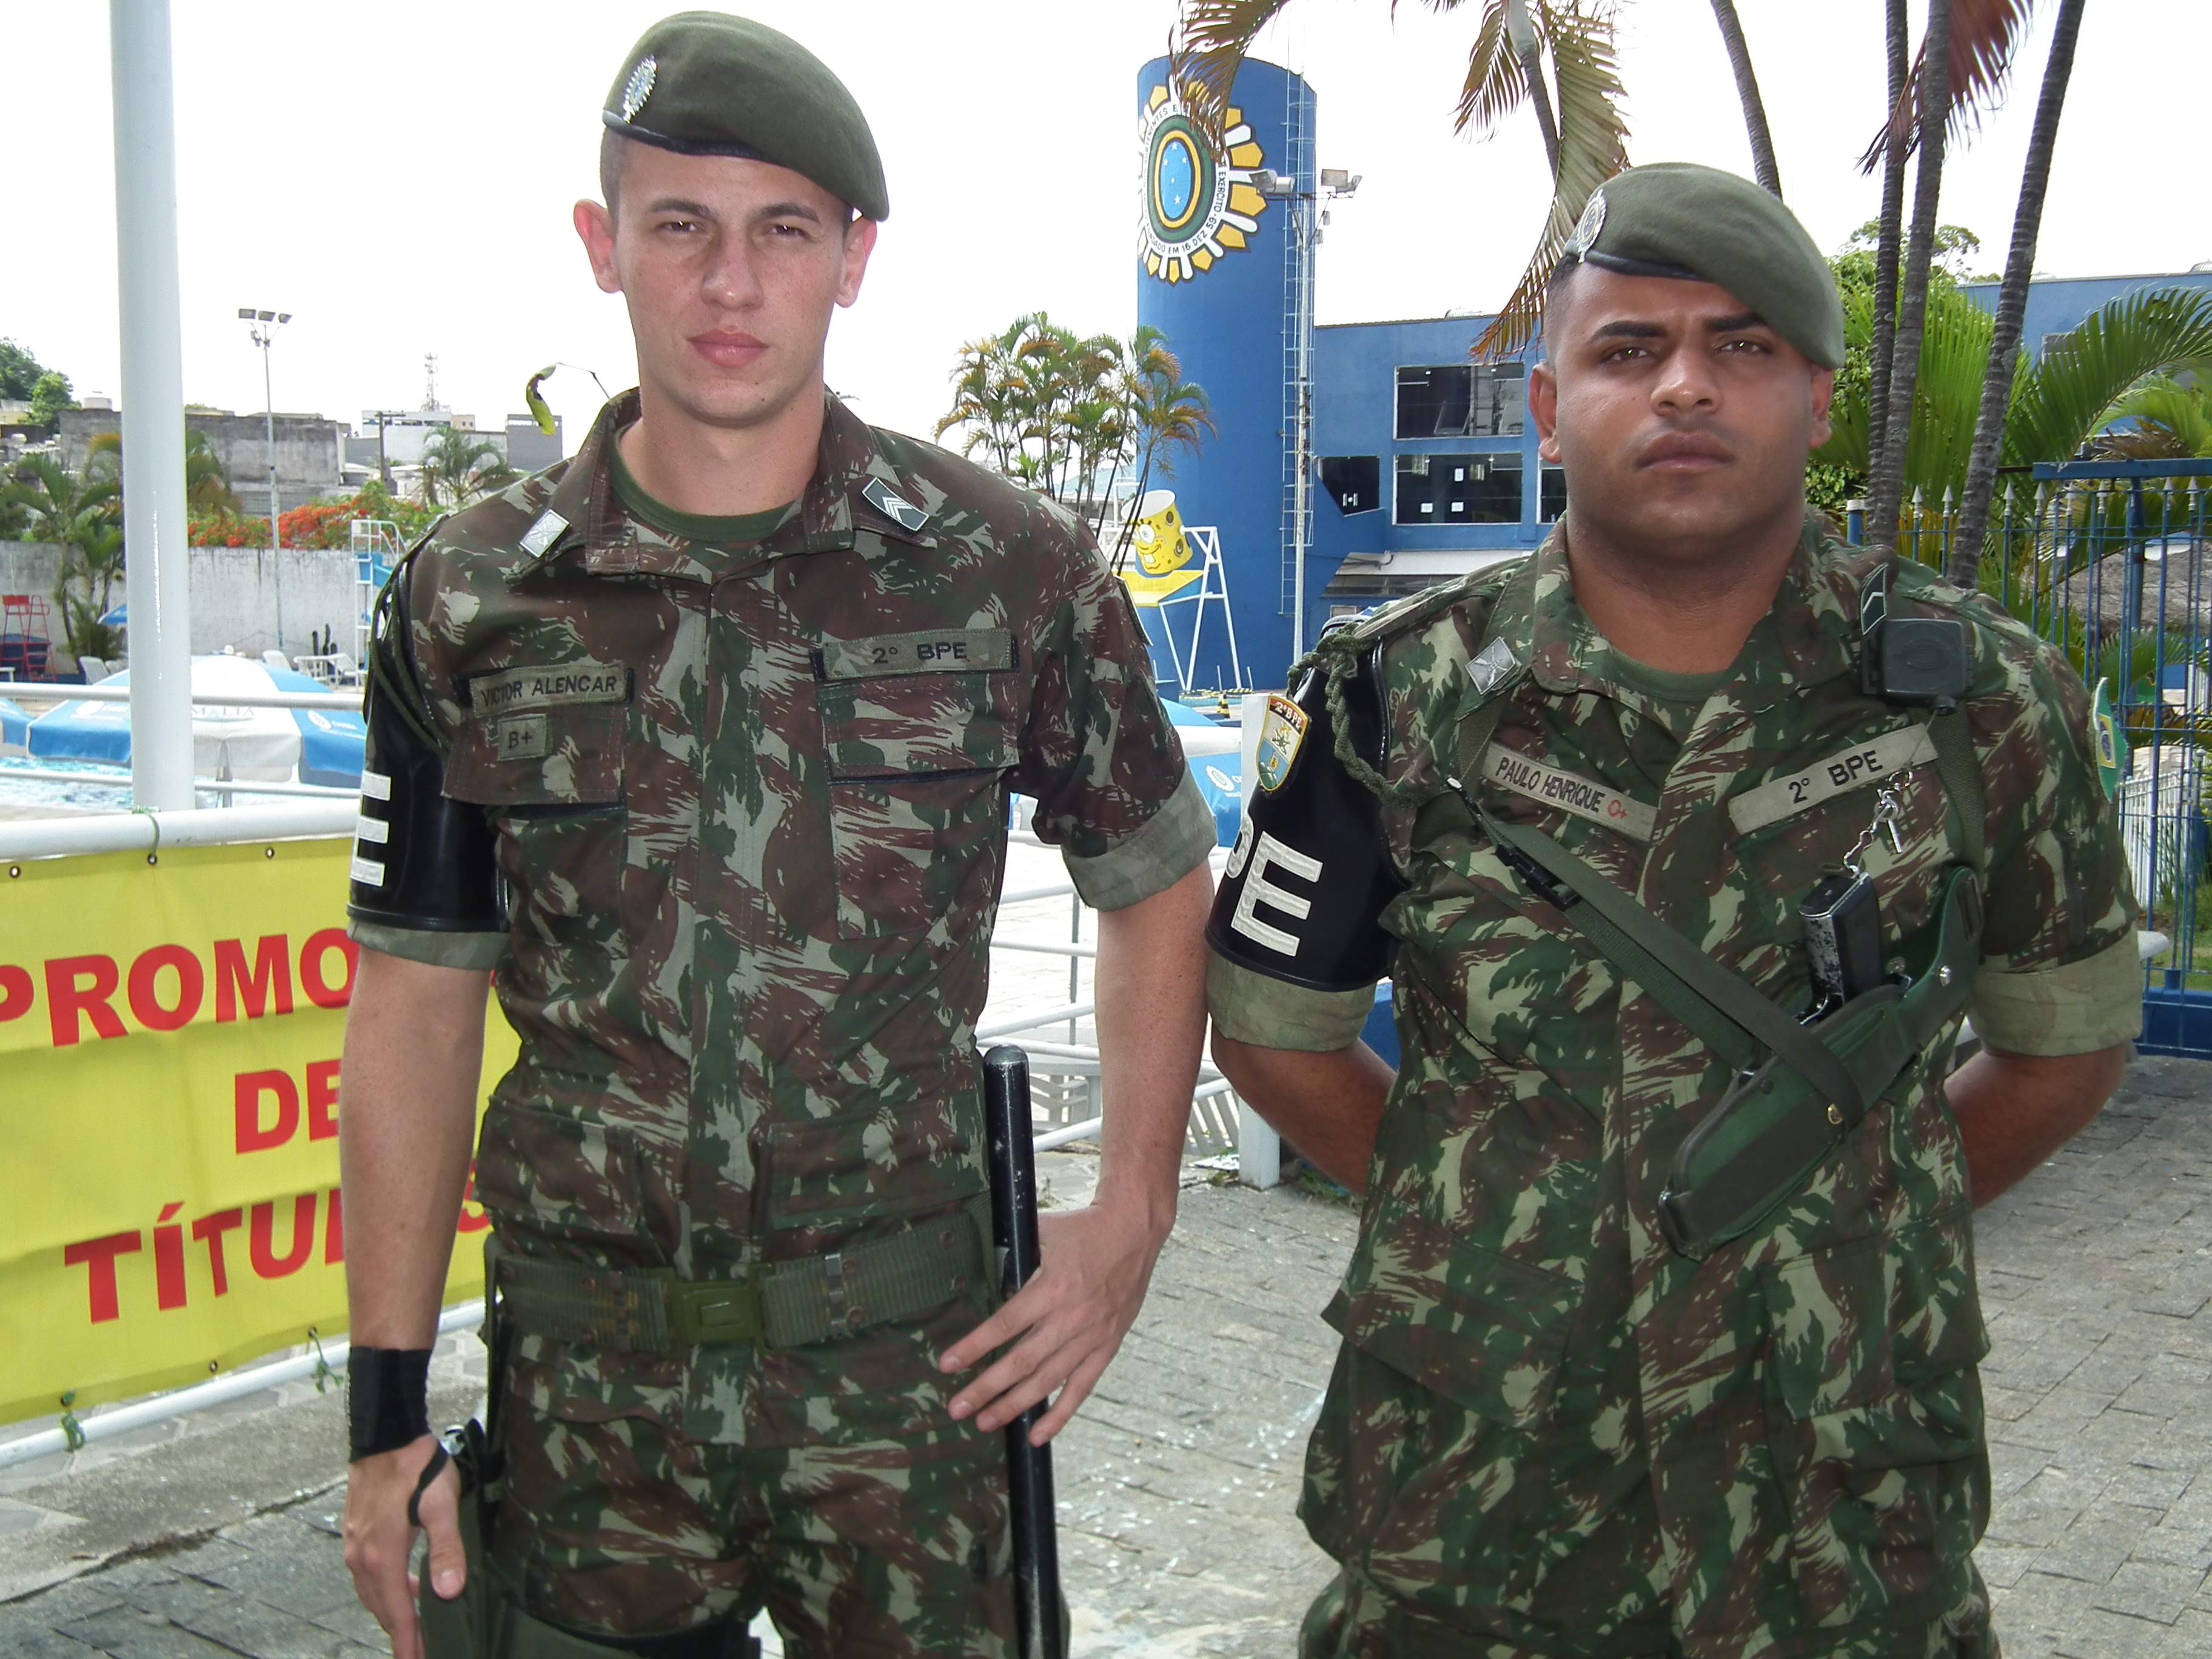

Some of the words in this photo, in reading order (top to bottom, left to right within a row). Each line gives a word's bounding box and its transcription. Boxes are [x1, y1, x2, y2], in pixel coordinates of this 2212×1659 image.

[1213, 172, 1227, 212] EXERCITO
[1182, 243, 1191, 252] 16
[1192, 230, 1208, 246] DEZ
[916, 642, 968, 660] BPE
[481, 681, 523, 707] VICTOR
[531, 675, 618, 696] ALENCAR
[508, 731, 532, 749] B+
[1827, 750, 1883, 786] BPE
[1495, 757, 1541, 791] PAULO
[1540, 774, 1606, 813] HENRIQUE
[1607, 799, 1628, 819] O+
[234, 1059, 341, 1155] DE
